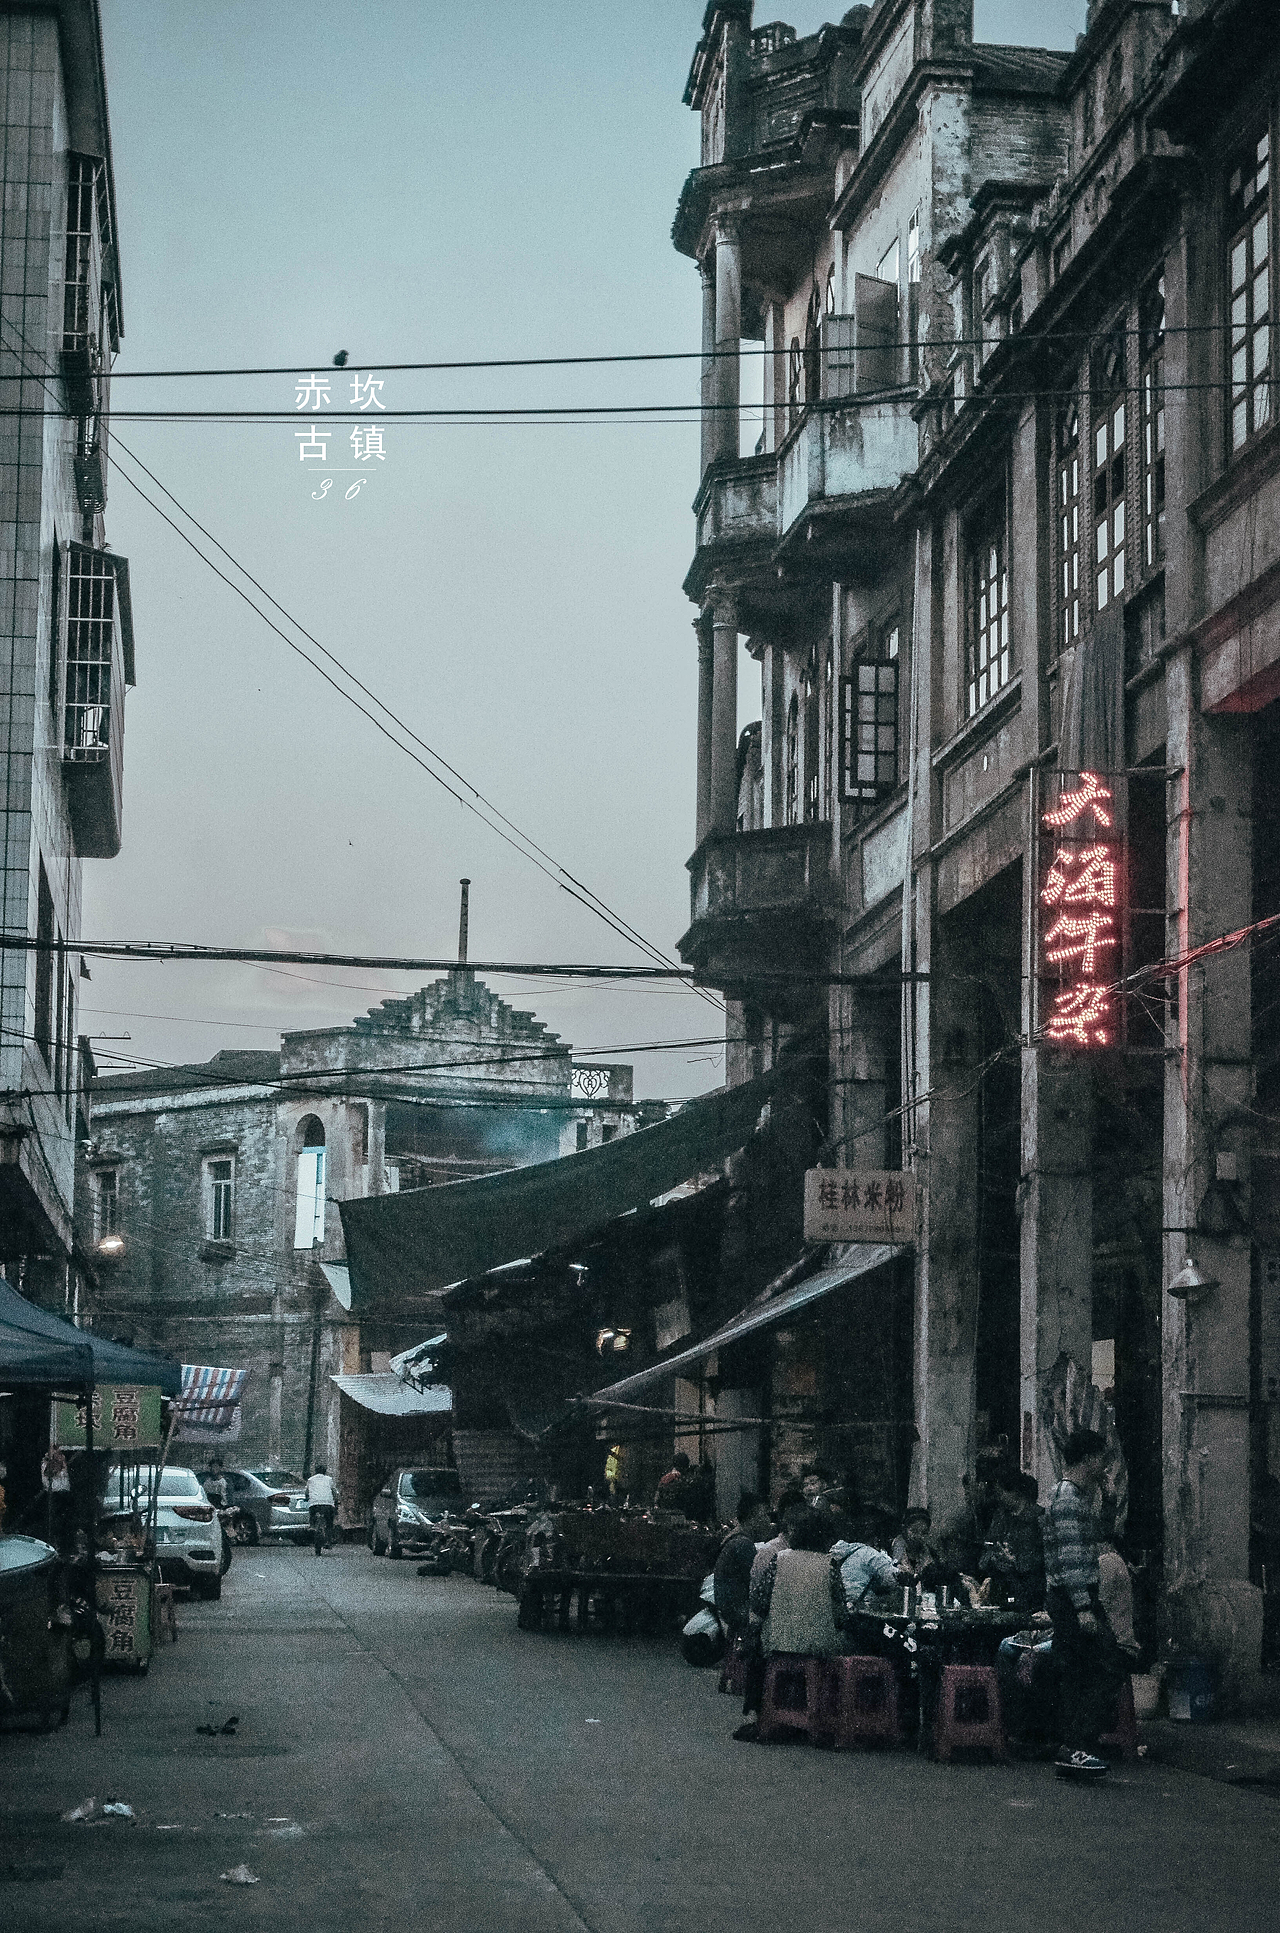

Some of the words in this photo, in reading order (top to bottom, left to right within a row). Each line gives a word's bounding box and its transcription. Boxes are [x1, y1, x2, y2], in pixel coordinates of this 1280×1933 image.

[818, 1178, 906, 1213] 桂林米粉
[112, 1389, 139, 1440] 豆腐角
[109, 1579, 137, 1652] 豆腐角
